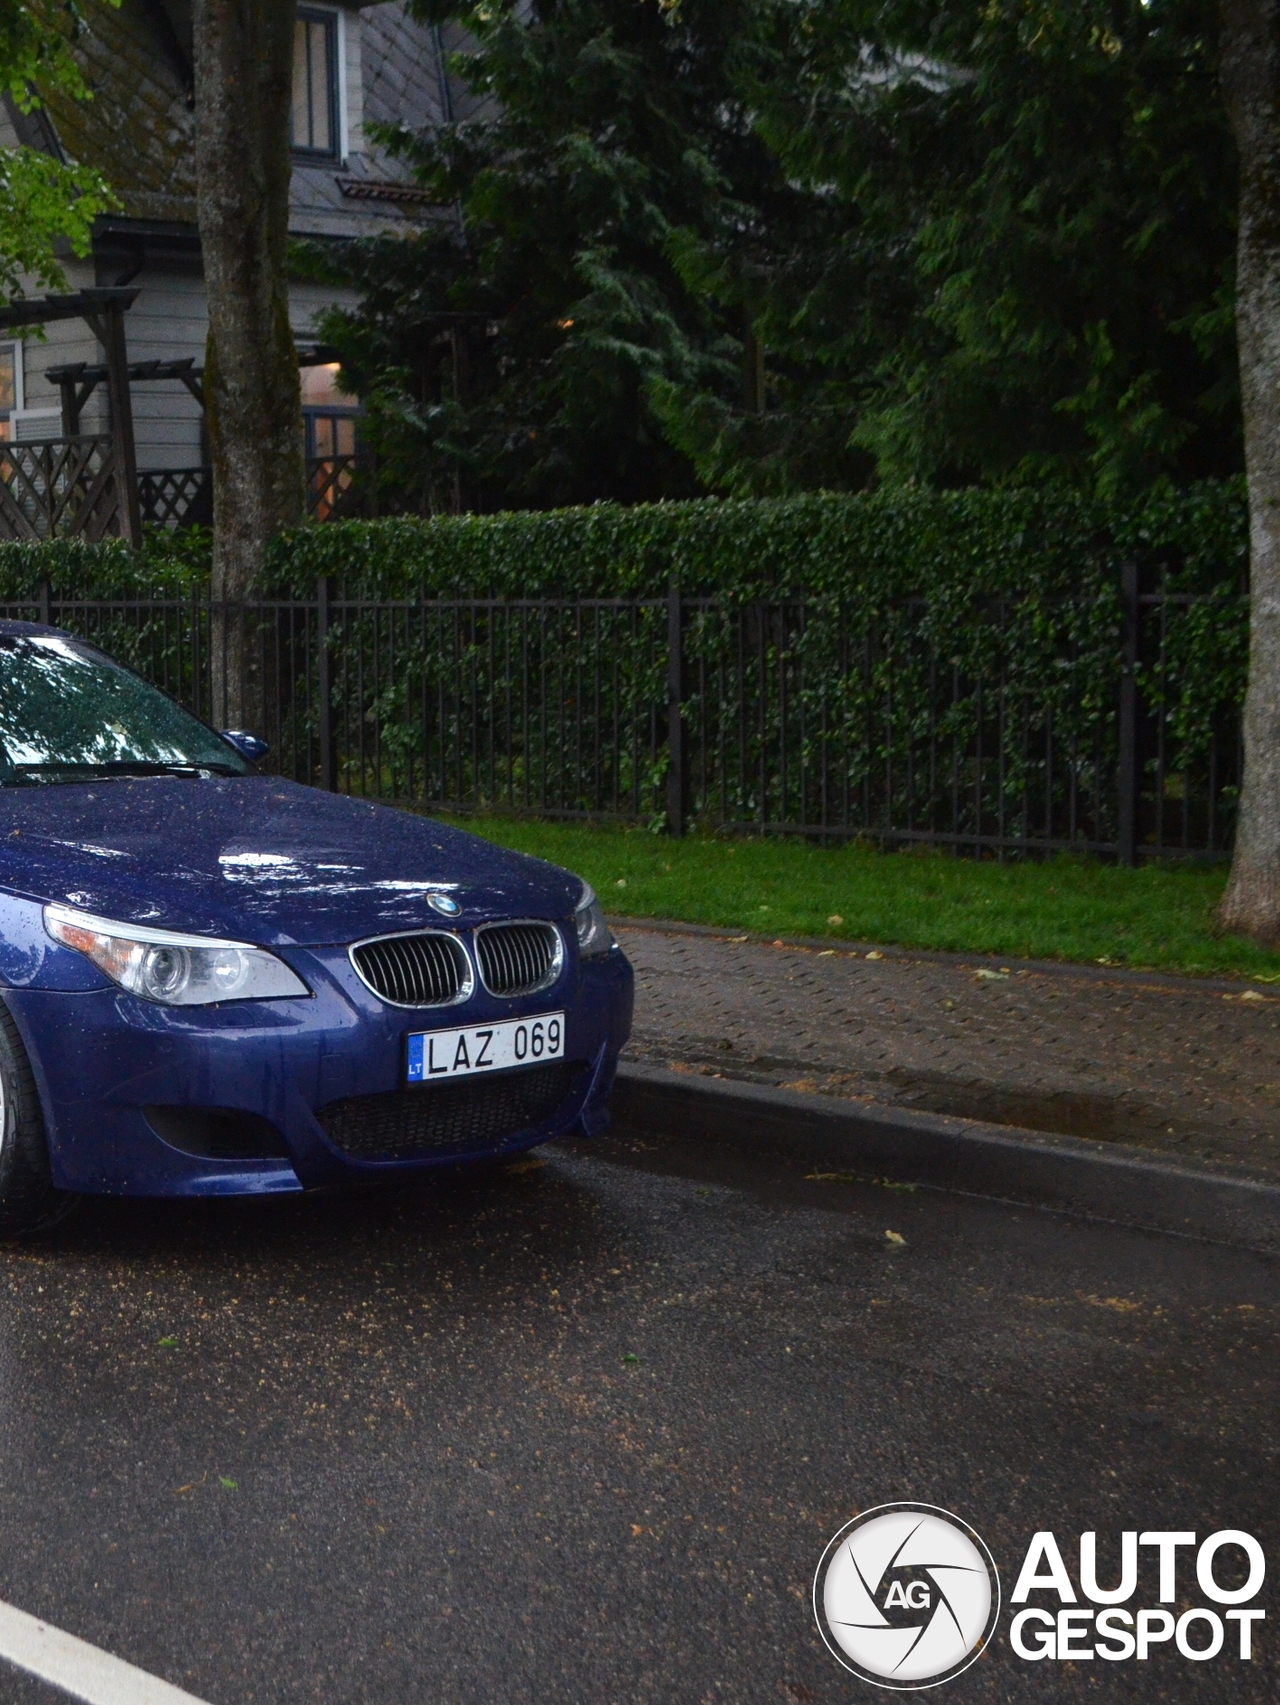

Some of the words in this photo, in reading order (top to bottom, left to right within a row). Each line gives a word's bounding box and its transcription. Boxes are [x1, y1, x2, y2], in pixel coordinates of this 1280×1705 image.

[428, 1030, 494, 1074] LAZ
[514, 1019, 561, 1060] 069
[408, 1062, 422, 1075] LT
